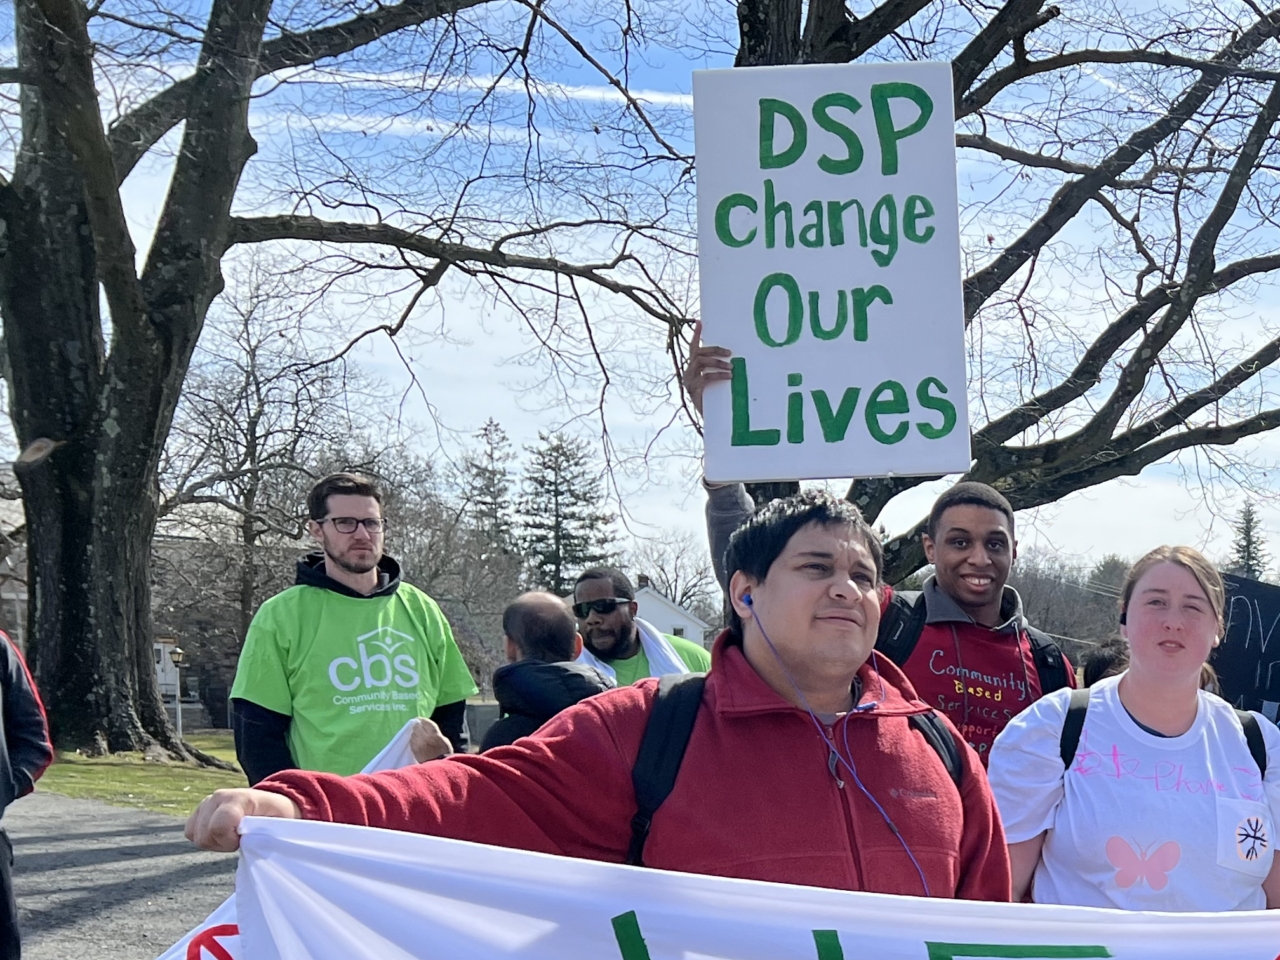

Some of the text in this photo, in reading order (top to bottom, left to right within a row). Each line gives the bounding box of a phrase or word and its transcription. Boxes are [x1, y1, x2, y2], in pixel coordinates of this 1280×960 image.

[758, 82, 934, 176] DSP
[753, 272, 894, 348] Our
[730, 357, 958, 447] Lives
[328, 643, 419, 691] cbs
[929, 649, 1027, 701] Community
[954, 680, 1002, 702] Based
[333, 691, 391, 705] Community
[349, 703, 409, 714] Services Inc.
